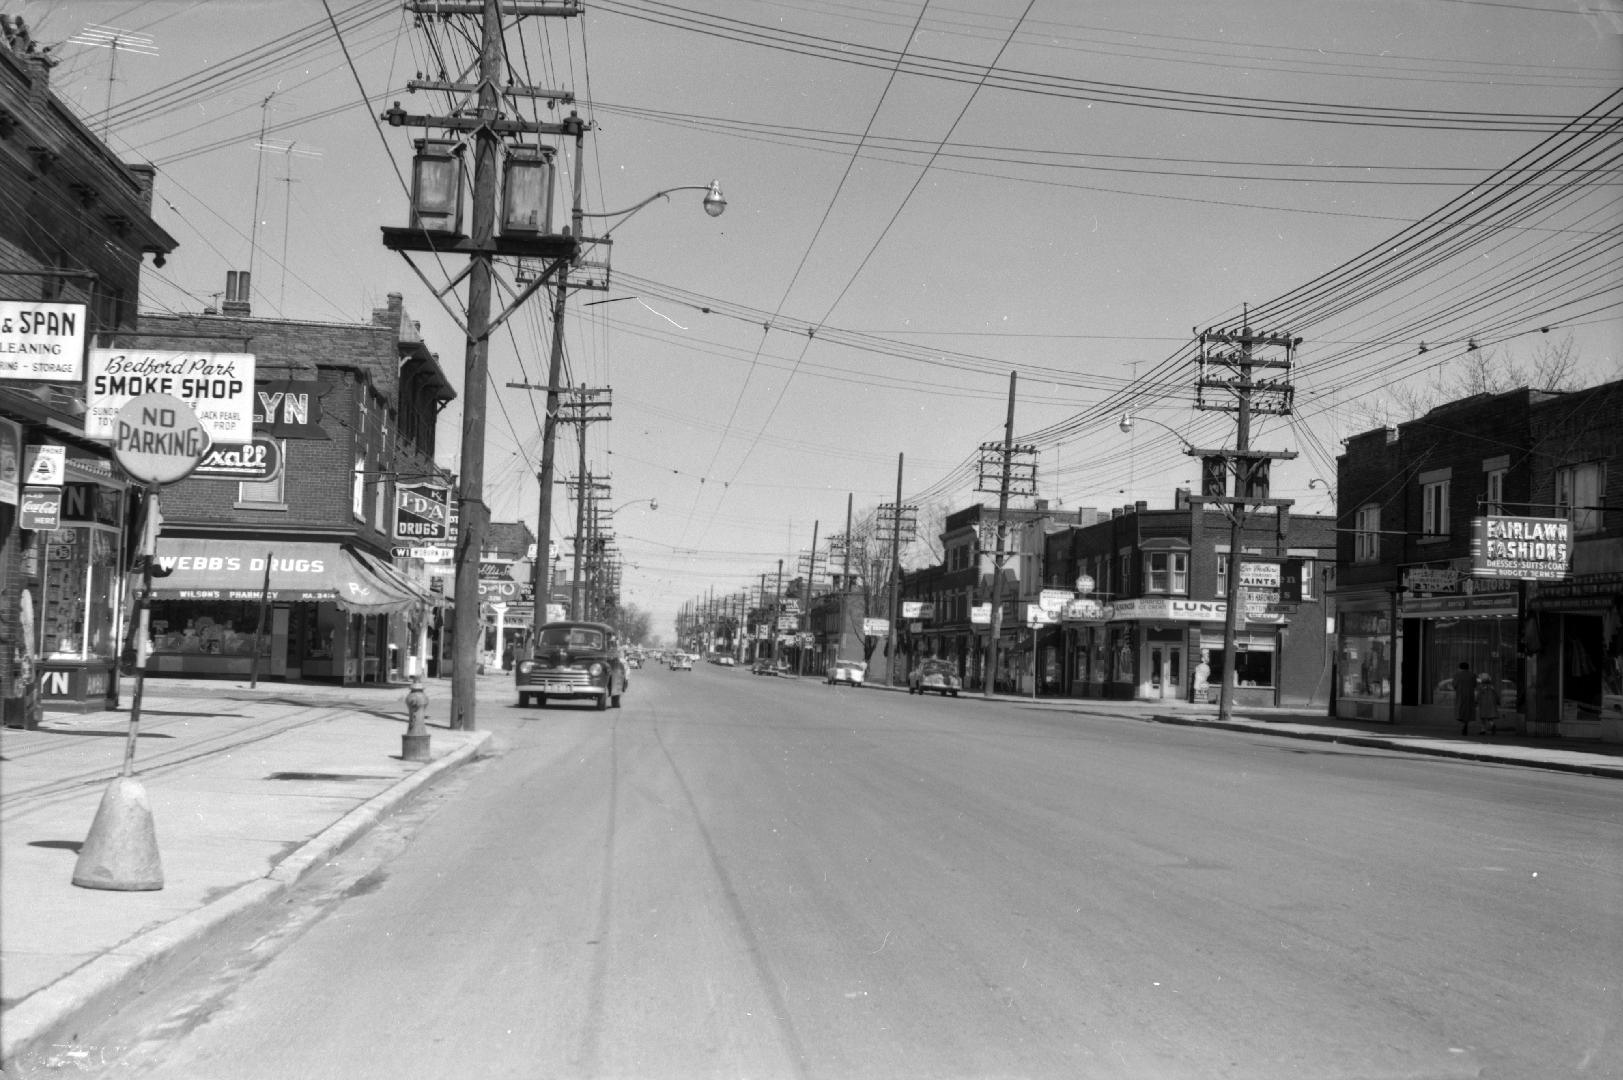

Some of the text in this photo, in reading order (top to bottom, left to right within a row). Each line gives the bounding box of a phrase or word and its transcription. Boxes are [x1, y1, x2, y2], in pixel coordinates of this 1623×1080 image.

[2, 311, 75, 336] & SPAN
[0, 342, 62, 355] LEANING
[32, 362, 73, 373] STORAGE
[104, 355, 235, 378] Bedford Park
[94, 375, 243, 400] SMOKE SHOP
[92, 407, 120, 416] SUNDR
[142, 407, 176, 428] NO
[252, 391, 309, 425] YN
[98, 416, 115, 426] TOY
[118, 420, 200, 457] PARKING
[200, 445, 267, 467] xall
[399, 522, 439, 536] DRUGS
[1487, 520, 1568, 541] FAIRLAWN
[1487, 540, 1568, 563] FASHIONS
[159, 556, 325, 573] WEBB'S DRUGS
[1499, 569, 1528, 577] BUDGET
[179, 590, 220, 598] WILSON'S
[1173, 602, 1227, 612] LUNC
